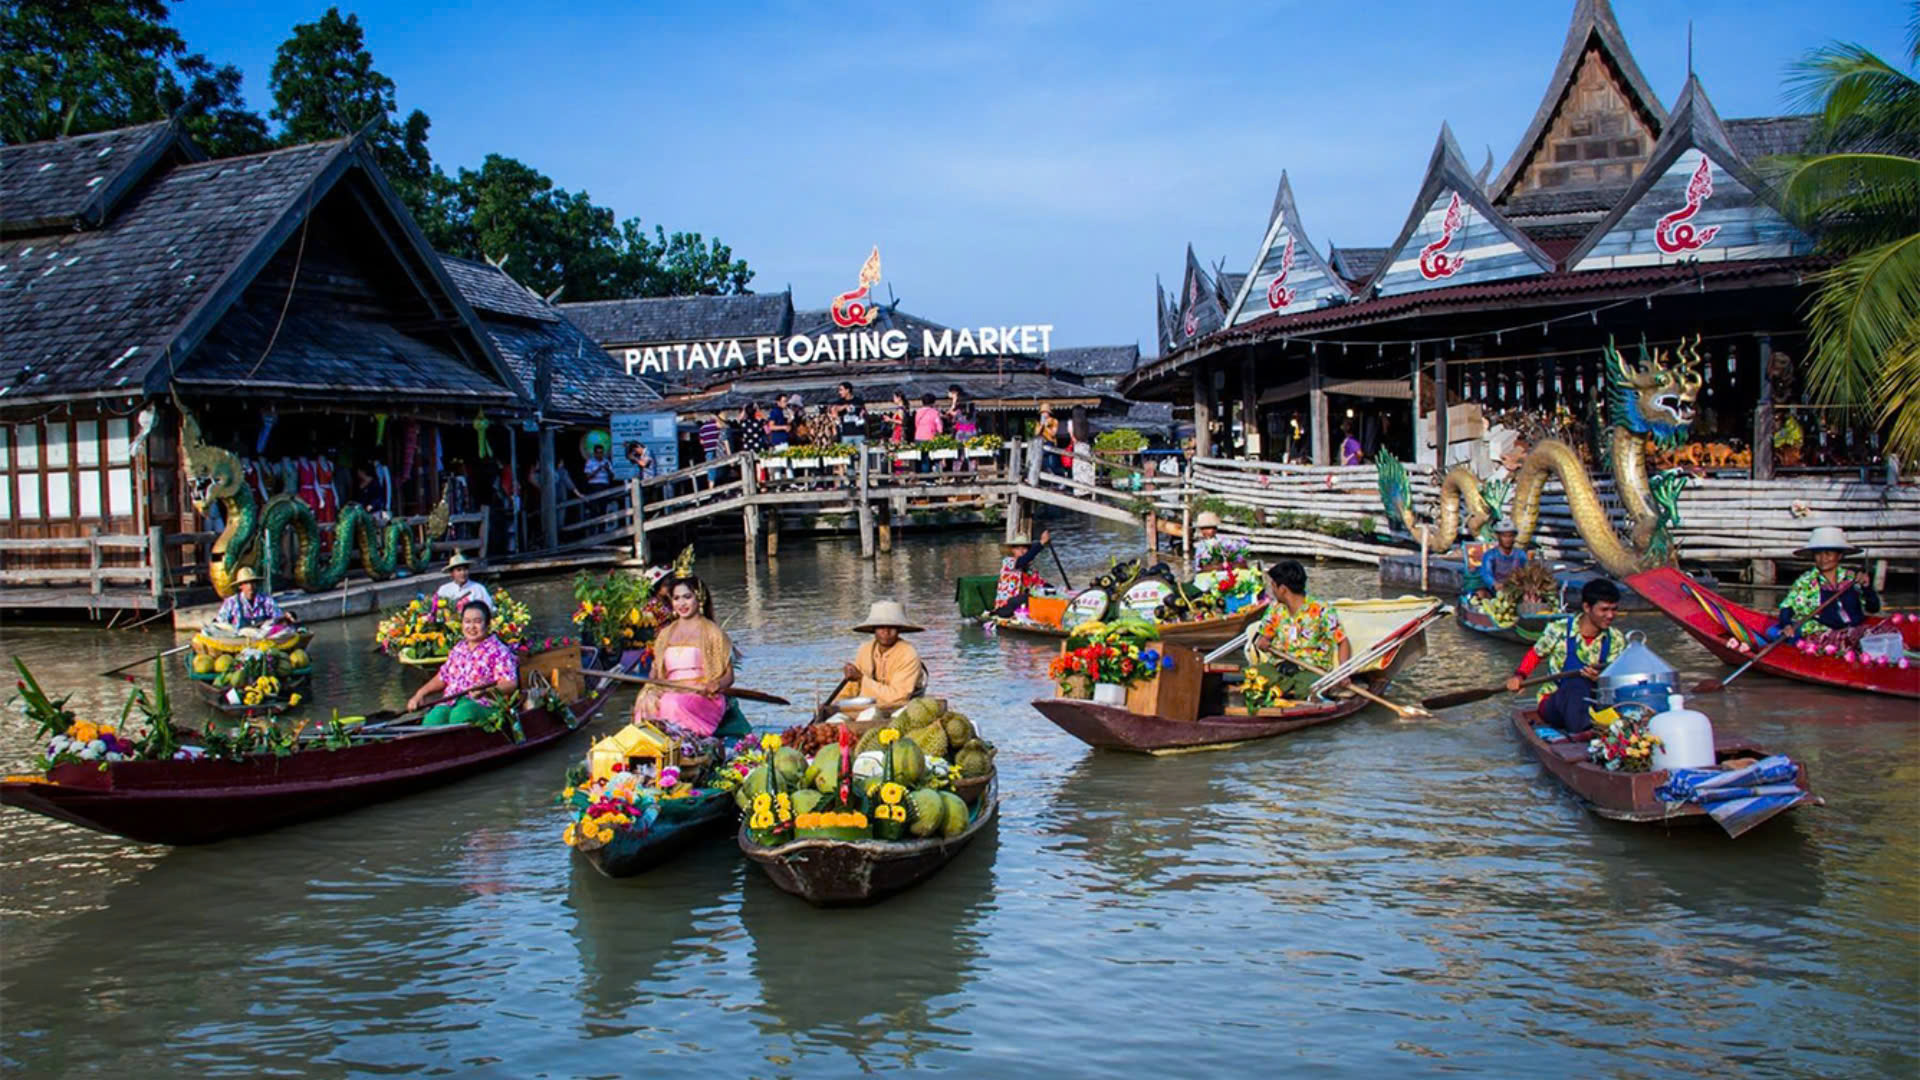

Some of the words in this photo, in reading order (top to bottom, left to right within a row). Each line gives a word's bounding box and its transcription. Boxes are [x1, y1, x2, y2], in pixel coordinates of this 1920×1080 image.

[625, 339, 746, 375] PATTAYA
[757, 329, 909, 366] FLOATING
[923, 325, 1054, 358] MARKET
